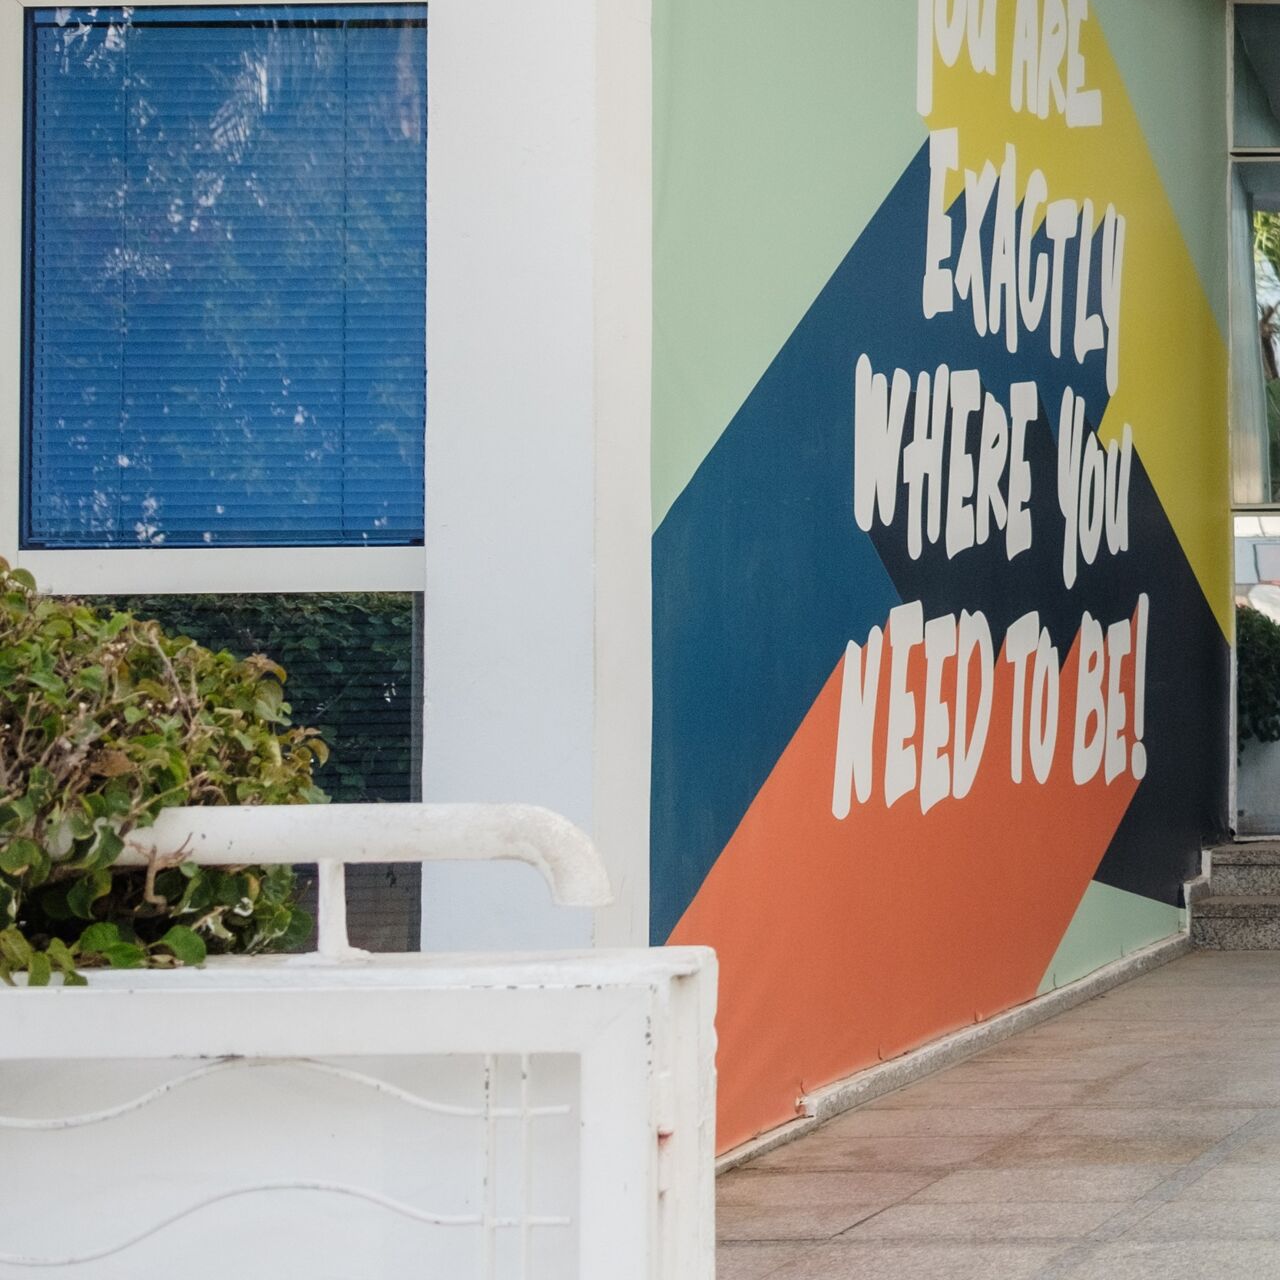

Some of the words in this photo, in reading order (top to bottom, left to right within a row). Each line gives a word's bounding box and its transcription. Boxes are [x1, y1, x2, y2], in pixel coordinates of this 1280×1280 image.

[924, 127, 1127, 397] EXACTLY
[854, 353, 1039, 561] WHERE
[1058, 385, 1132, 590] YOU
[831, 600, 994, 821] NEED
[1004, 608, 1059, 785] TO
[1072, 592, 1148, 787] BE!
